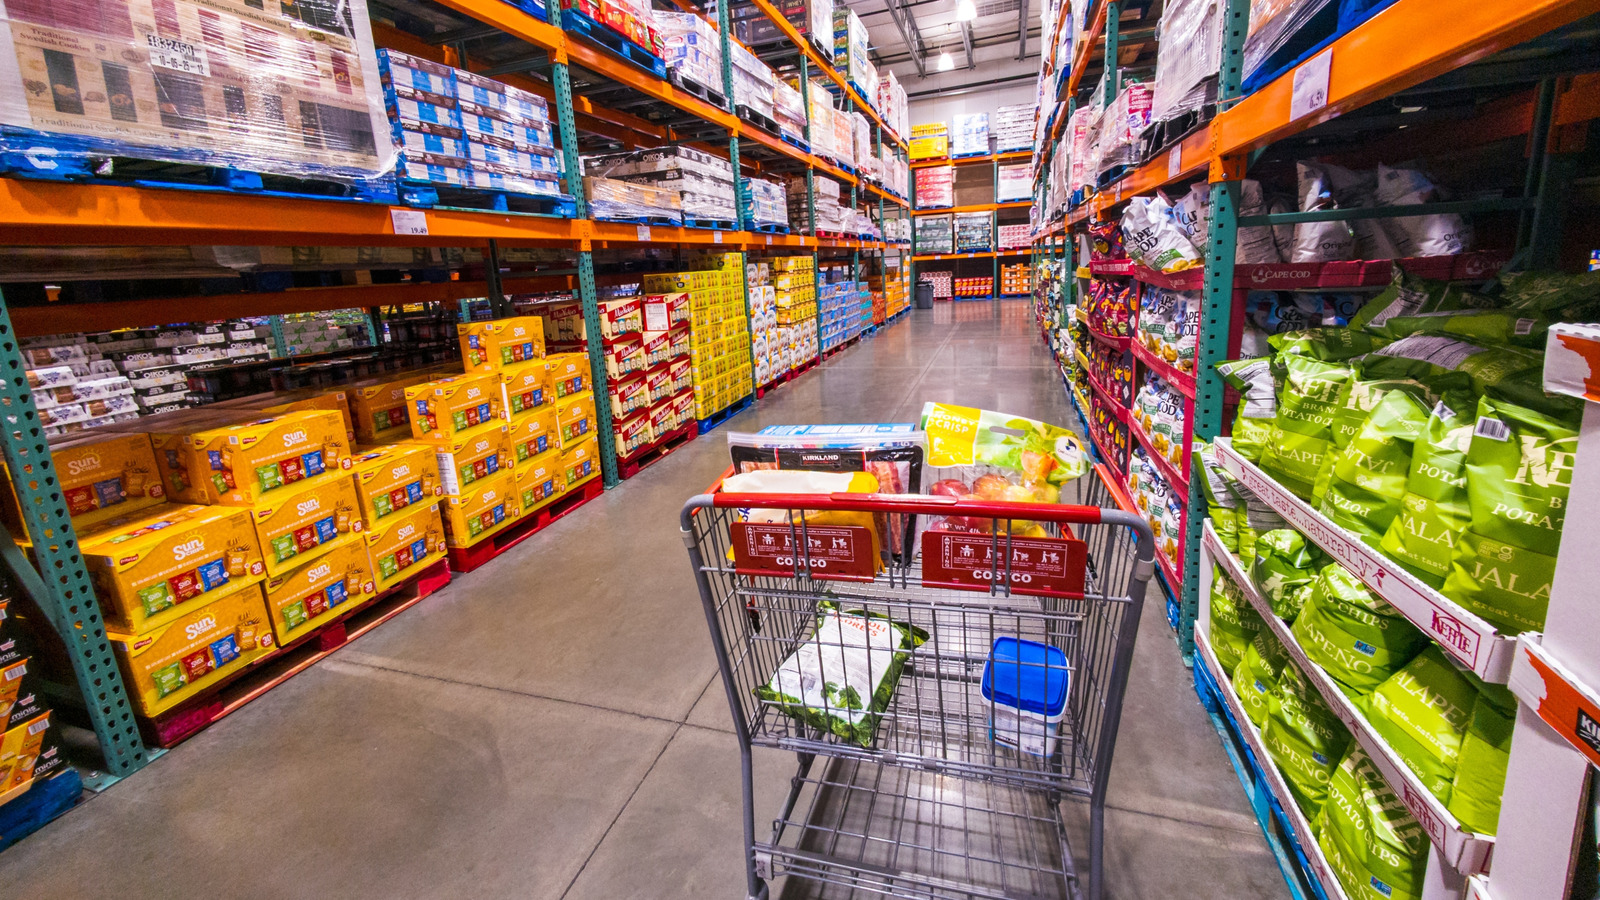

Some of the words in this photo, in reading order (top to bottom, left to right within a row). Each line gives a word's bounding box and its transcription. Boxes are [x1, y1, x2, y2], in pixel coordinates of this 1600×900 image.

[20, 32, 57, 45] Swedish
[58, 41, 91, 52] Cookies
[31, 27, 79, 43] Traditional
[40, 119, 93, 130] Traditional
[604, 158, 626, 167] OIKOS
[642, 152, 665, 162] OIKOS
[410, 227, 428, 235] 19.49
[1133, 226, 1154, 244] APE
[1139, 237, 1159, 254] OD
[1264, 270, 1289, 279] CAPE
[1290, 270, 1310, 279] COD
[186, 346, 211, 355] OIKOS
[230, 341, 252, 350] OIKOS
[127, 352, 153, 361] OIKOS
[143, 369, 170, 379] OIKOS
[154, 404, 181, 414] OIKOS
[935, 419, 969, 433] CRISP
[282, 430, 308, 447] Sun
[68, 456, 100, 475] Sun
[392, 464, 410, 480] Sun
[1248, 474, 1271, 500] great
[297, 498, 320, 516] Sun
[173, 539, 204, 561] Sun
[747, 530, 756, 555] WARNING
[776, 557, 827, 568] COSTCO
[307, 564, 331, 583] Sun
[1337, 601, 1390, 631] CHIPS
[1472, 600, 1510, 619] great
[185, 617, 216, 640] Sun
[1430, 608, 1473, 658] KETTLE
[11, 705, 37, 721] minis
[34, 758, 60, 775] minis
[1403, 782, 1441, 841] KETTLE
